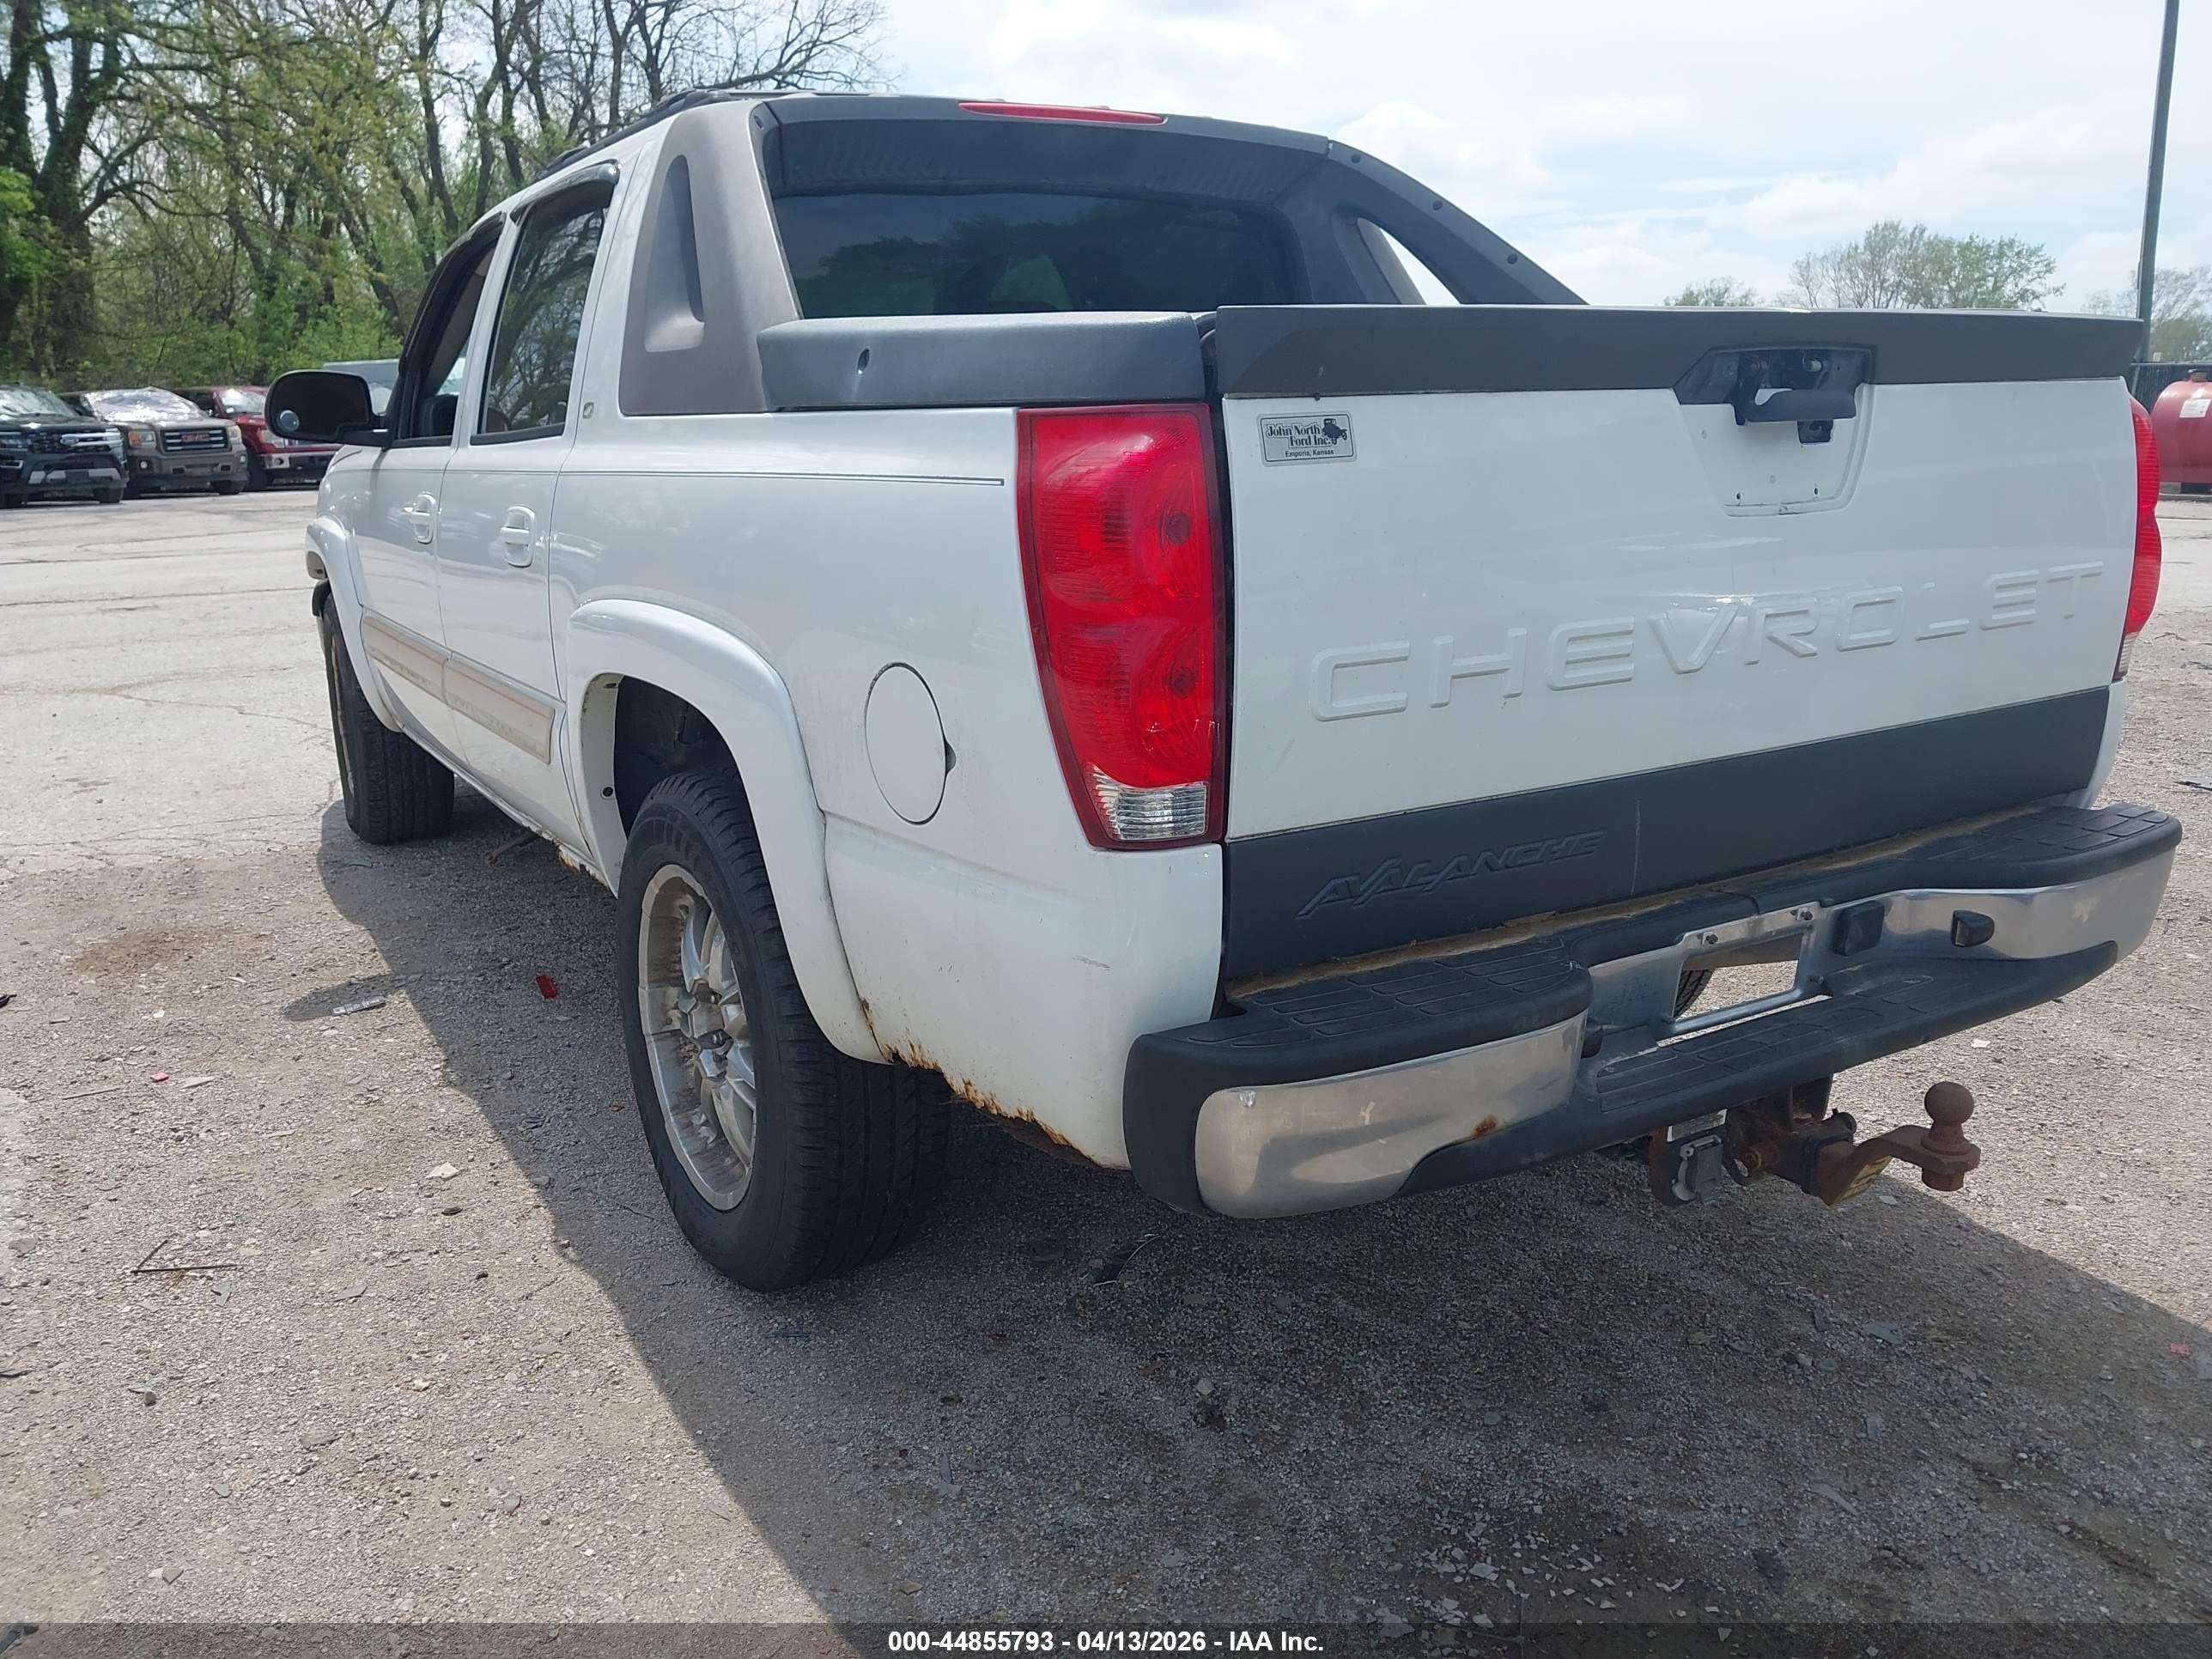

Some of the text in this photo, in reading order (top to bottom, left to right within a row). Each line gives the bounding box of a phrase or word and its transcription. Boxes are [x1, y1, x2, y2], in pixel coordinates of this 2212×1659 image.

[1267, 423, 1321, 436] John North
[1290, 434, 1331, 447] Ford Inc.
[1285, 449, 1312, 458] Emporia,
[1310, 561, 2105, 721] CHEVROLET
[1295, 830, 1603, 920] AVALANCHE
